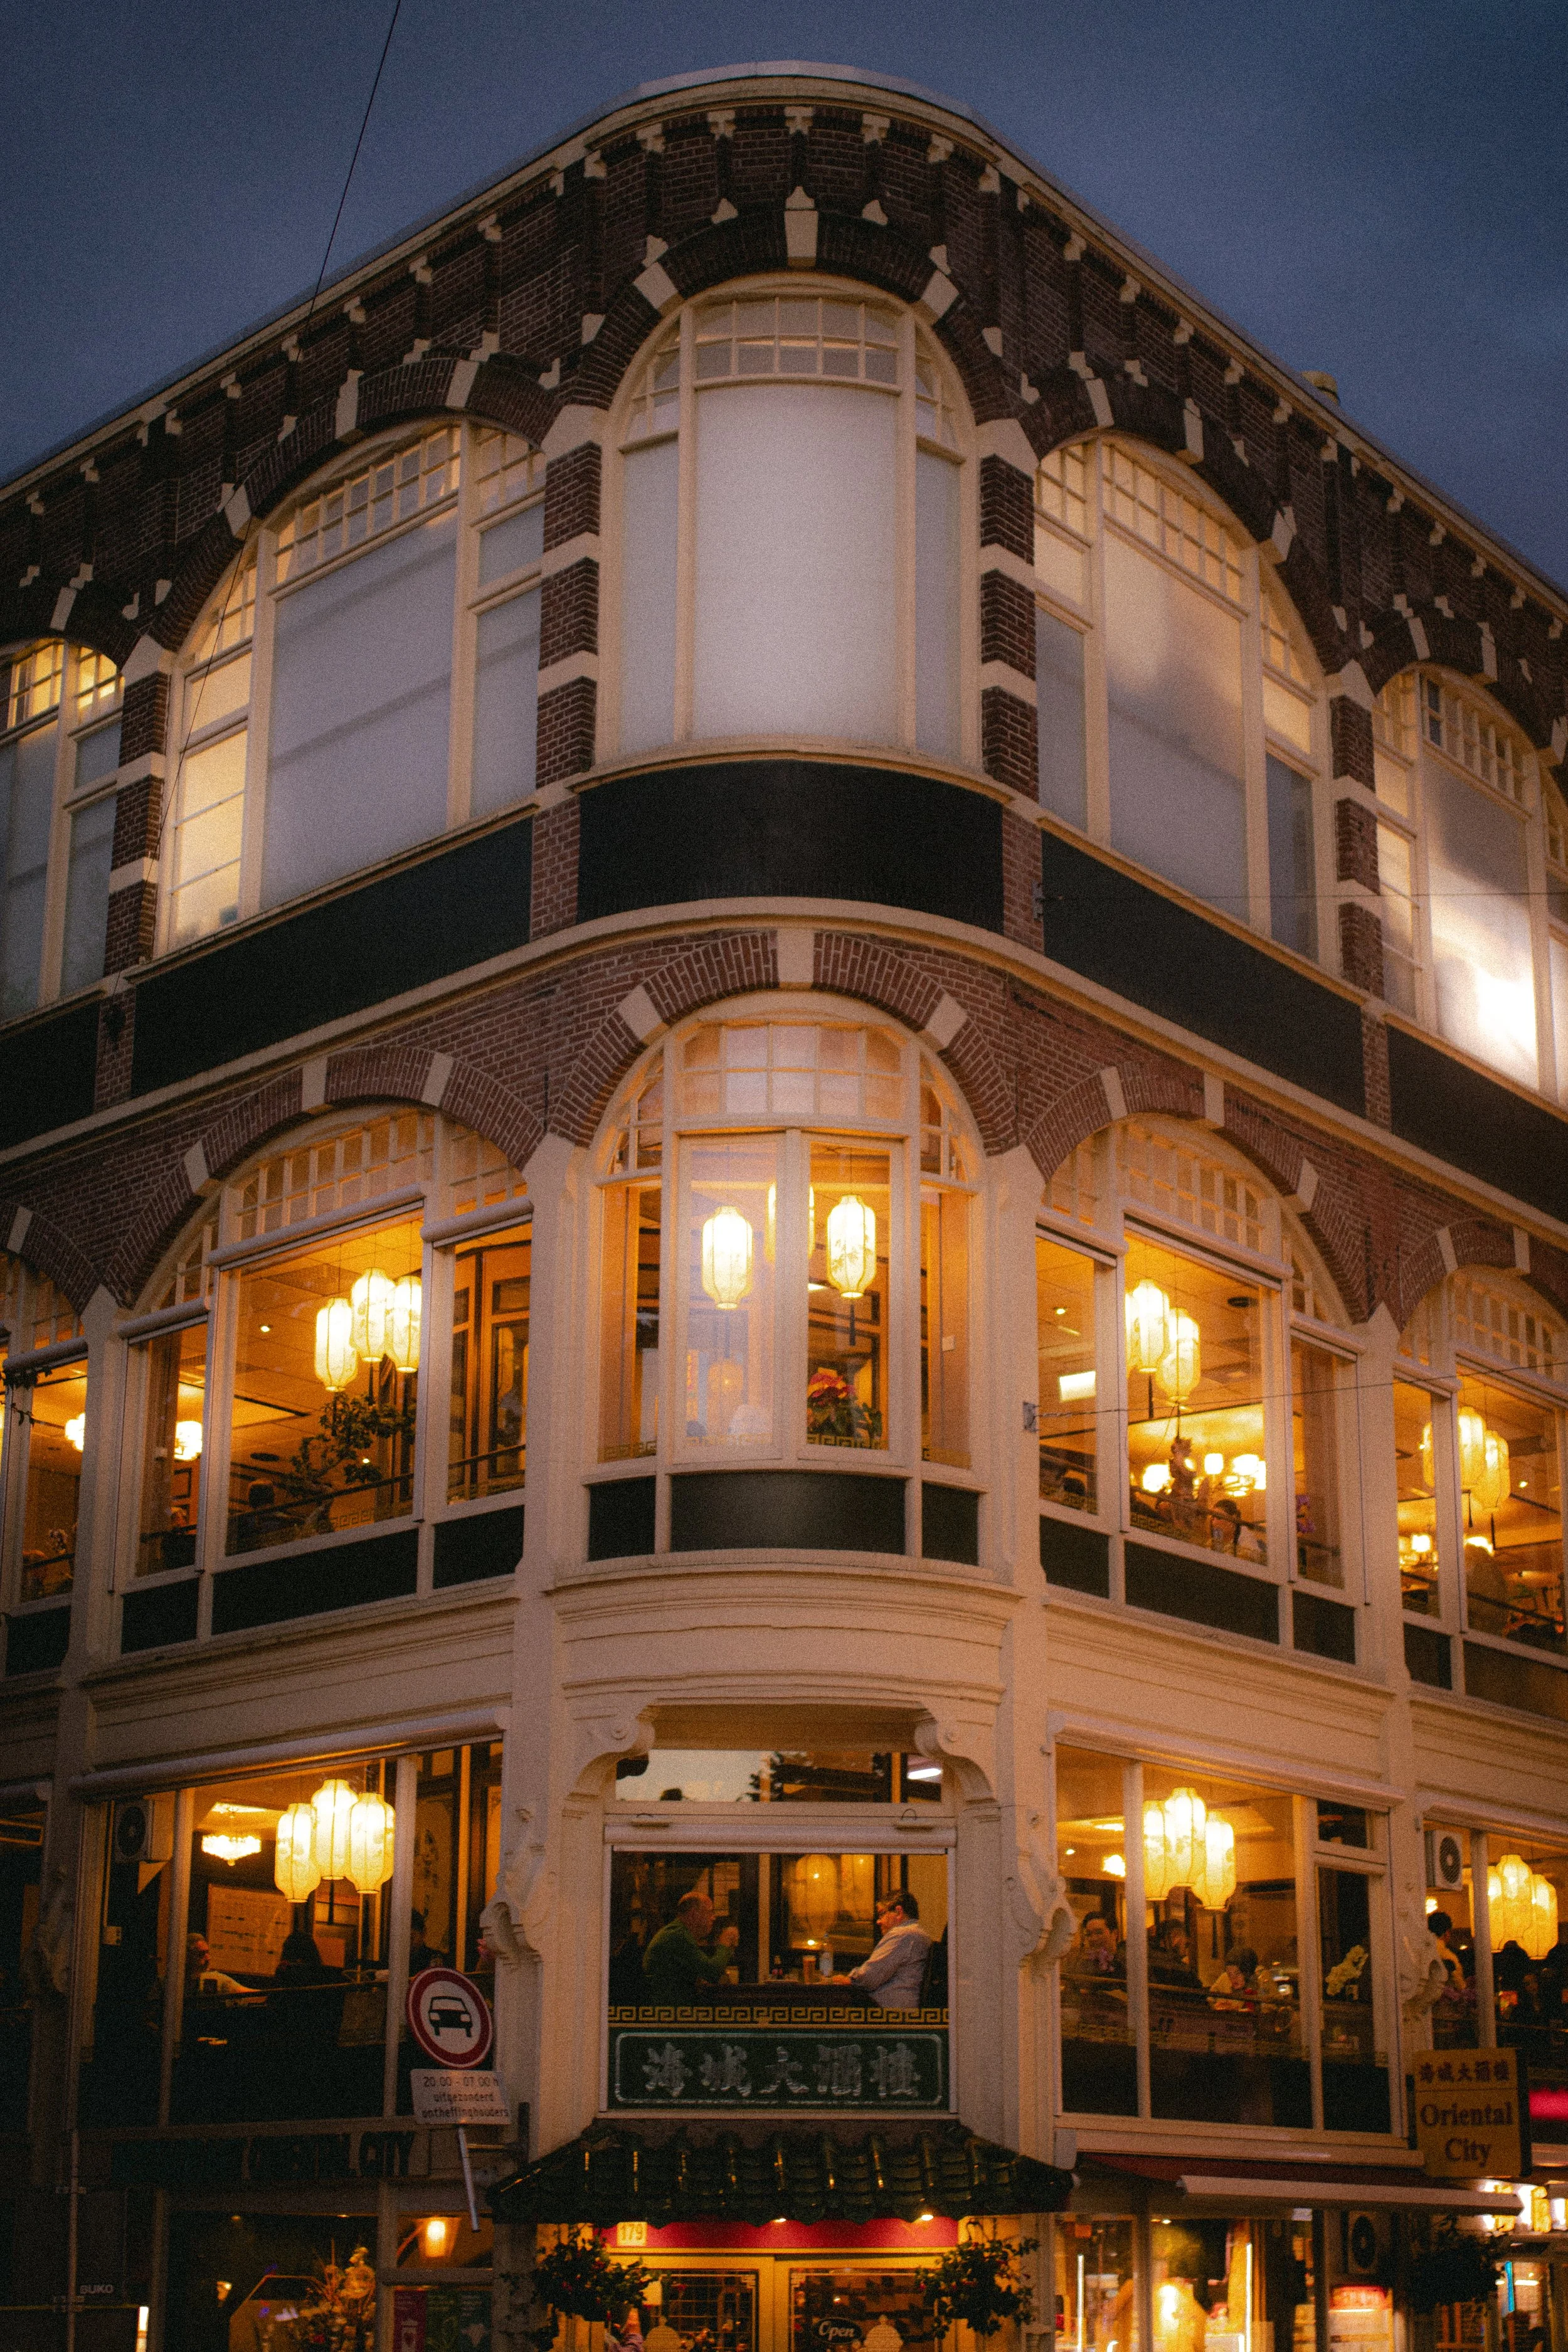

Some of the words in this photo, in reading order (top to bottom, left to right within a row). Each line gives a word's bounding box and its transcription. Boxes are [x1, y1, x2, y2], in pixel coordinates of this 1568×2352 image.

[1420, 2102, 1513, 2127] Oriental
[1444, 2137, 1491, 2168] City
[620, 2223, 644, 2241] 179
[80, 2284, 114, 2295] BUKO
[818, 2321, 855, 2341] Open
